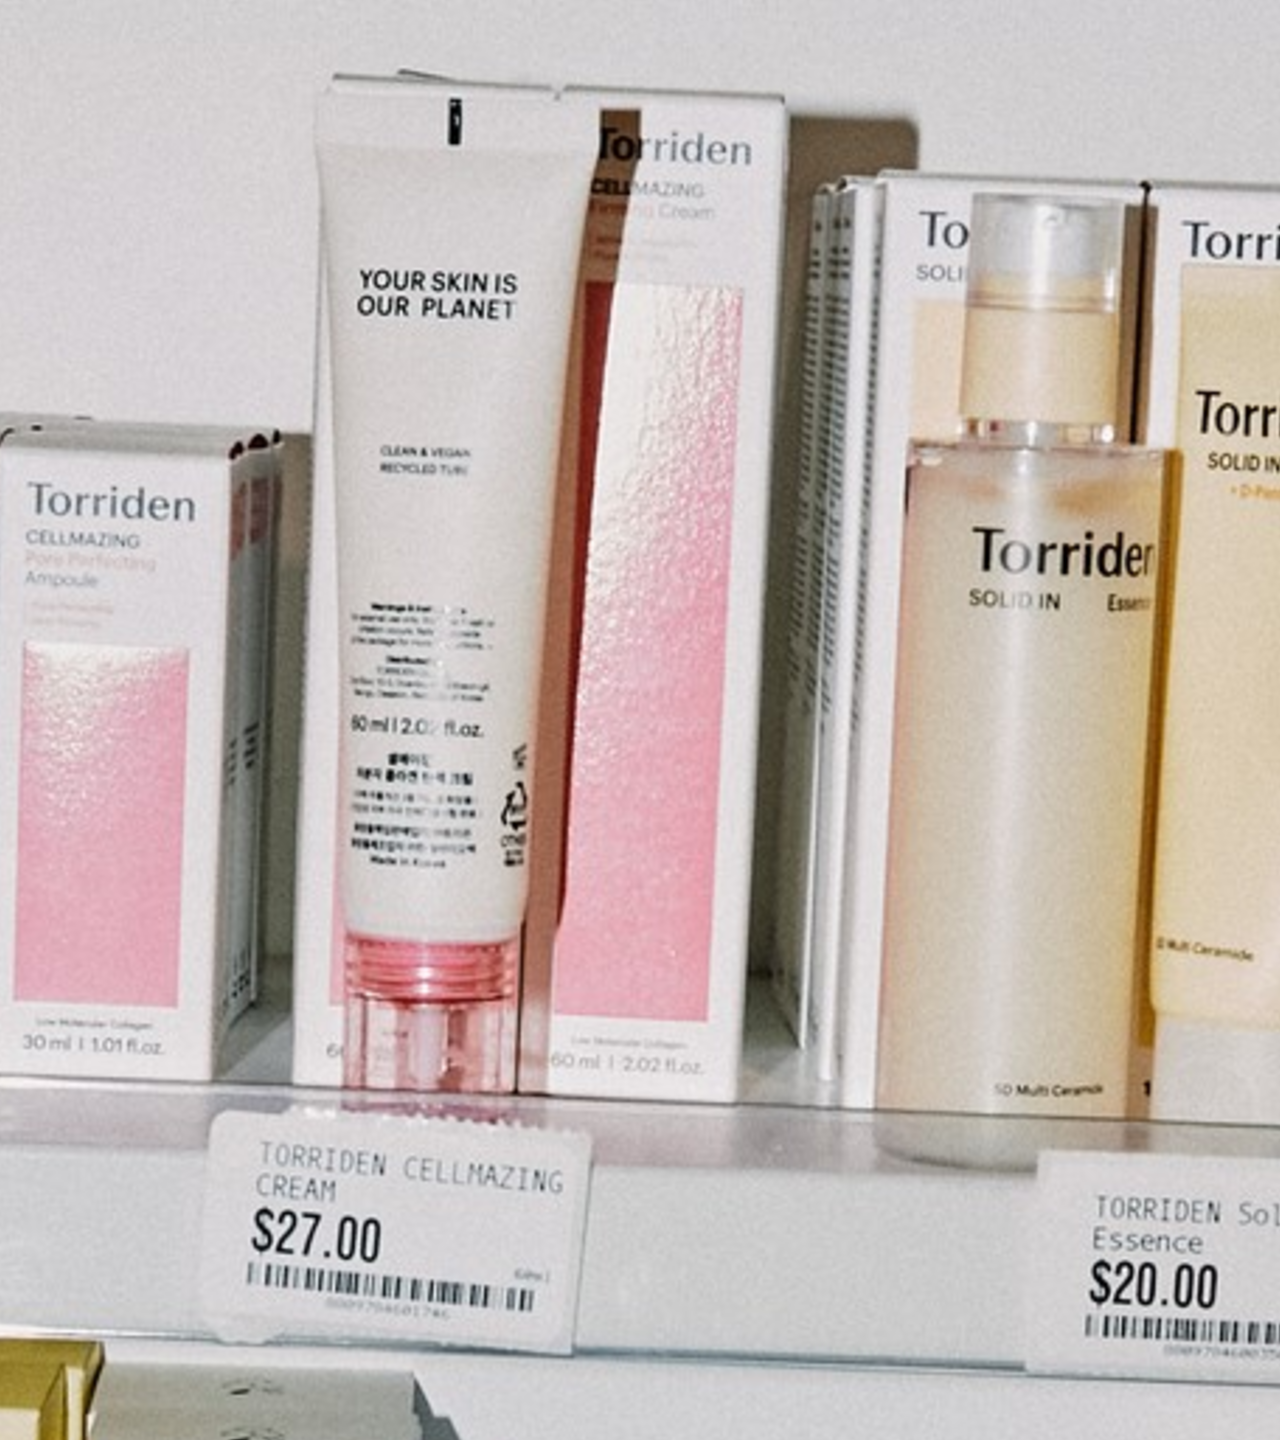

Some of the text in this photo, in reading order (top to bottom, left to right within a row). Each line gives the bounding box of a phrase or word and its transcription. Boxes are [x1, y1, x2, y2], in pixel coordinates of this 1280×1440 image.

[359, 269, 518, 295] YOUR SKIN IS
[357, 295, 516, 320] OUR PLANET
[1207, 452, 1262, 472] SOLID
[27, 483, 196, 522] Torriden
[25, 529, 141, 550] CELLMAZING
[260, 1140, 564, 1195] TORRIDEN CELLMAZING
[256, 1173, 337, 1203] CREAM
[1096, 1195, 1221, 1224] TORRIDEN
[251, 1207, 382, 1262] $27.00
[1093, 1226, 1204, 1255] Essence
[1089, 1259, 1218, 1309] $20.00
